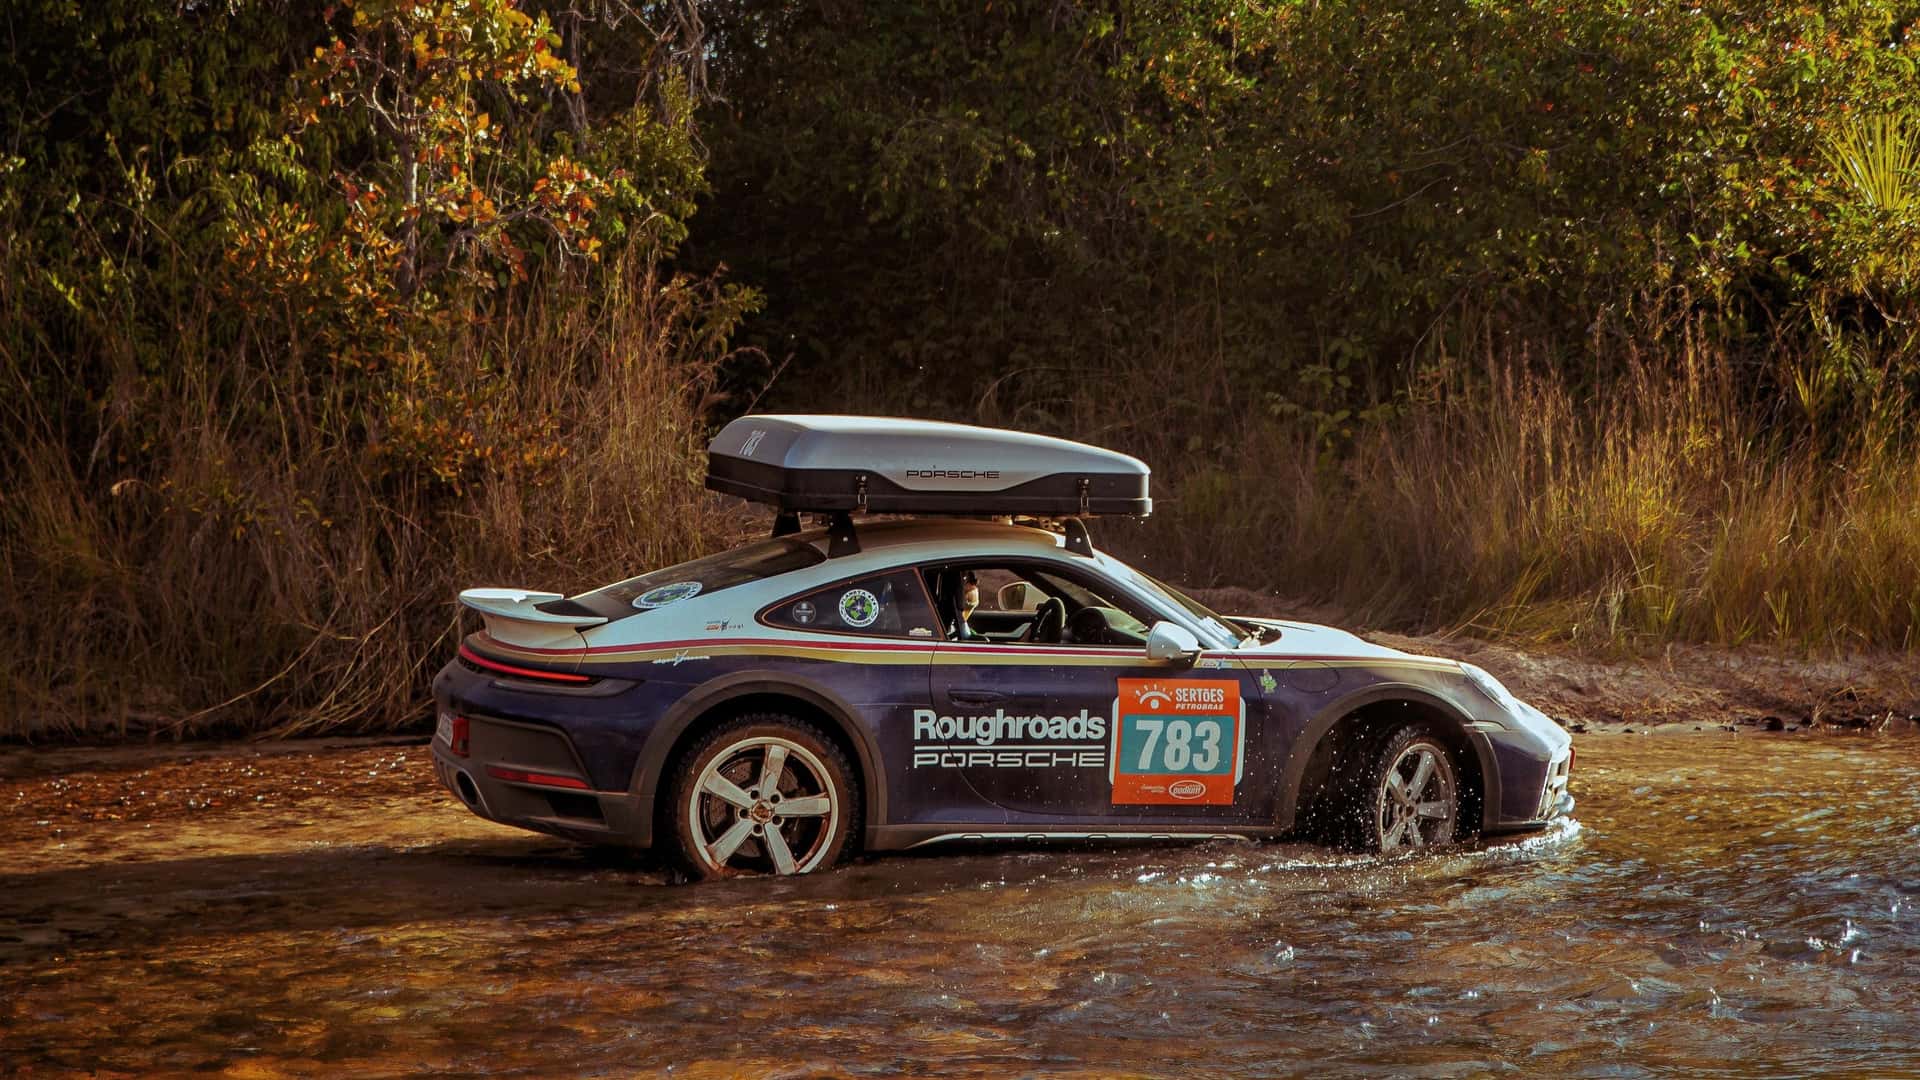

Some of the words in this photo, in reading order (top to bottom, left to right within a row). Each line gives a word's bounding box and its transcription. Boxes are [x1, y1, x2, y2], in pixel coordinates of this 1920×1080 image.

[906, 470, 1000, 480] PORSCHE
[1175, 687, 1224, 703] SERTÕES
[1175, 703, 1224, 711] PETROBRAS
[913, 708, 1106, 746] Roughroads
[1135, 719, 1221, 772] 783
[913, 752, 1105, 769] PORSCHE
